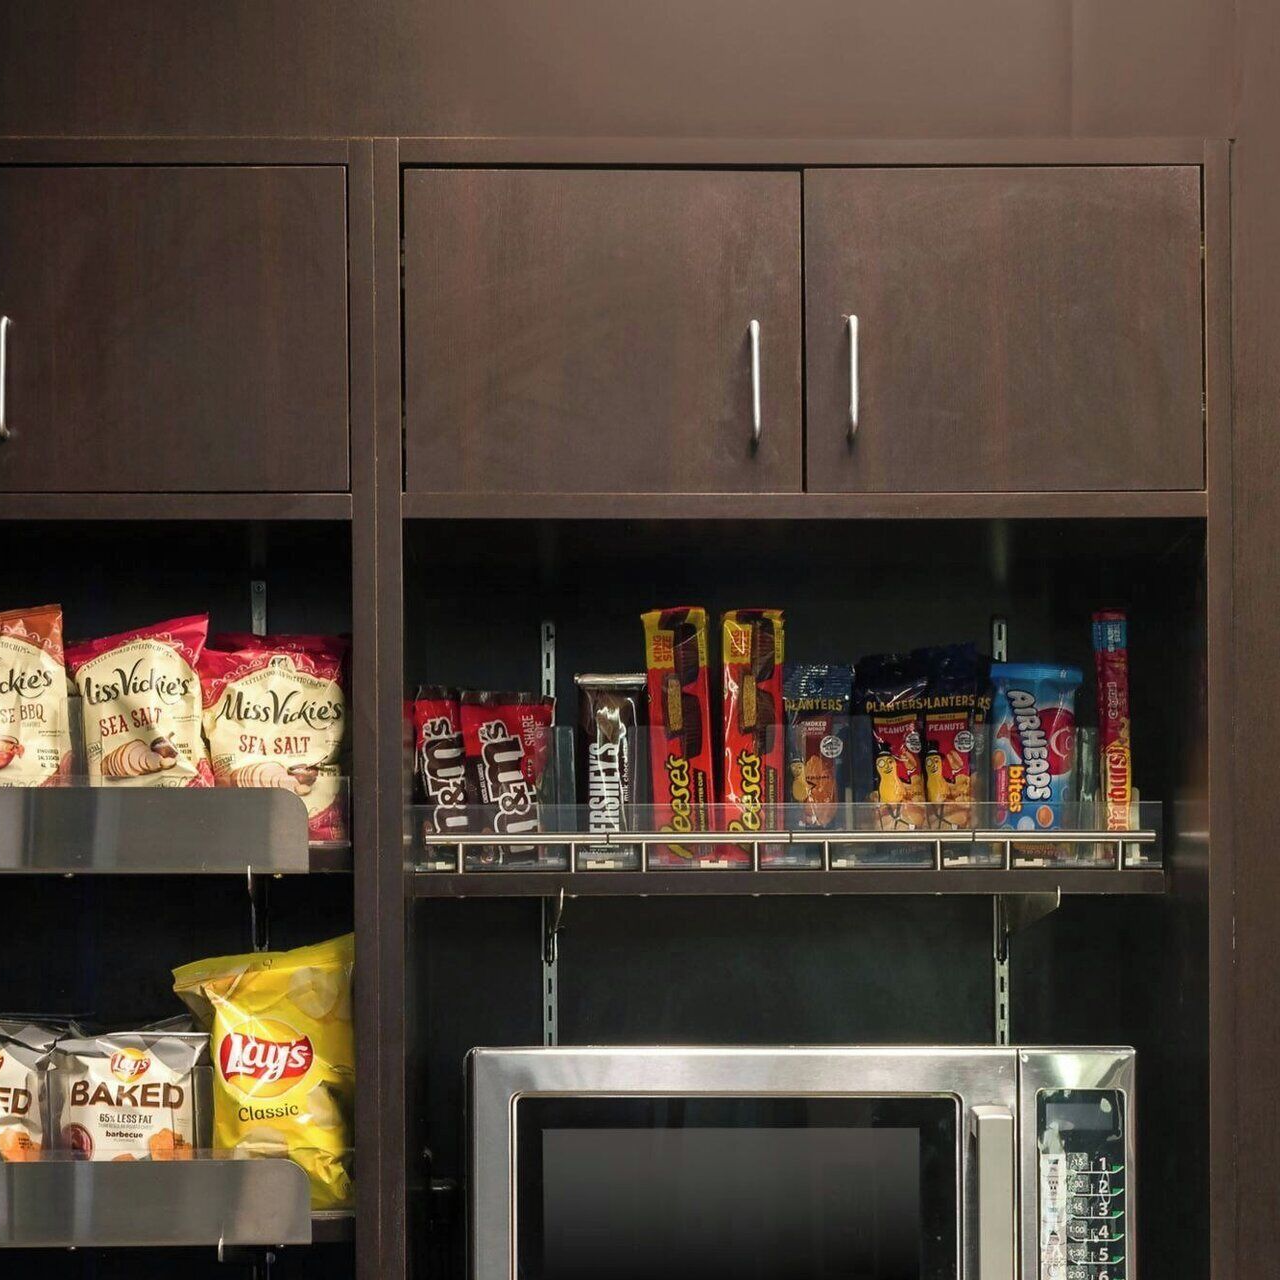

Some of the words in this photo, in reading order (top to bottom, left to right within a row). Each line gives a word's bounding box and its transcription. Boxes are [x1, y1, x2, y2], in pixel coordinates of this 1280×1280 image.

[652, 635, 663, 663] KING
[662, 636, 674, 661] SIZE
[20, 703, 47, 723] BBQ
[785, 699, 843, 712] PLANTERS
[866, 699, 923, 714] PLANTERS
[99, 714, 129, 737] SEA
[131, 706, 163, 728] SALT
[878, 724, 915, 734] PEANUTS
[928, 723, 965, 731] PEANUTS
[521, 714, 535, 747] SHARE
[239, 734, 267, 756] SEA
[273, 736, 311, 755] SALT
[1008, 766, 1025, 813] bites
[226, 1033, 313, 1082] Lay's
[71, 1080, 185, 1110] BAKED
[117, 1114, 137, 1124] LESS
[138, 1114, 153, 1124] FAT
[238, 1102, 300, 1123] Classic
[105, 1130, 143, 1139] barbecue
[1099, 1157, 1106, 1170] 1
[1099, 1180, 1109, 1193] 2
[1099, 1202, 1109, 1216] 3
[1099, 1225, 1109, 1238] 4
[1099, 1247, 1109, 1261] 5
